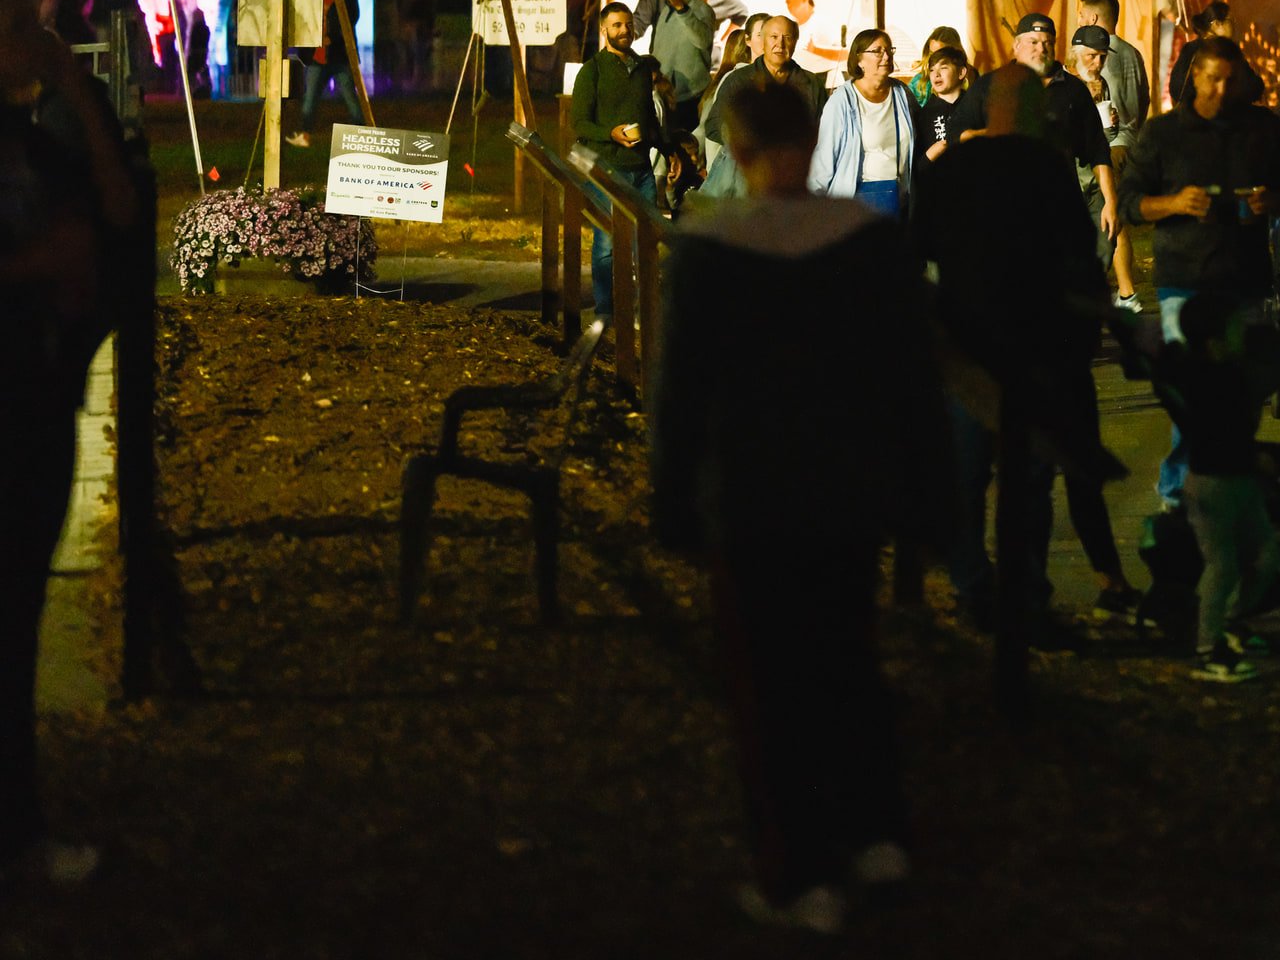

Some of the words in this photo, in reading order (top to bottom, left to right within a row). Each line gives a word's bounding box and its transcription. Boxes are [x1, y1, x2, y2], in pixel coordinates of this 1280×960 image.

[343, 134, 401, 147] HEADLESS
[341, 142, 400, 155] HORSEMAN
[338, 161, 360, 169] THANK
[339, 176, 362, 184] BANK
[376, 179, 415, 189] AMERICA
